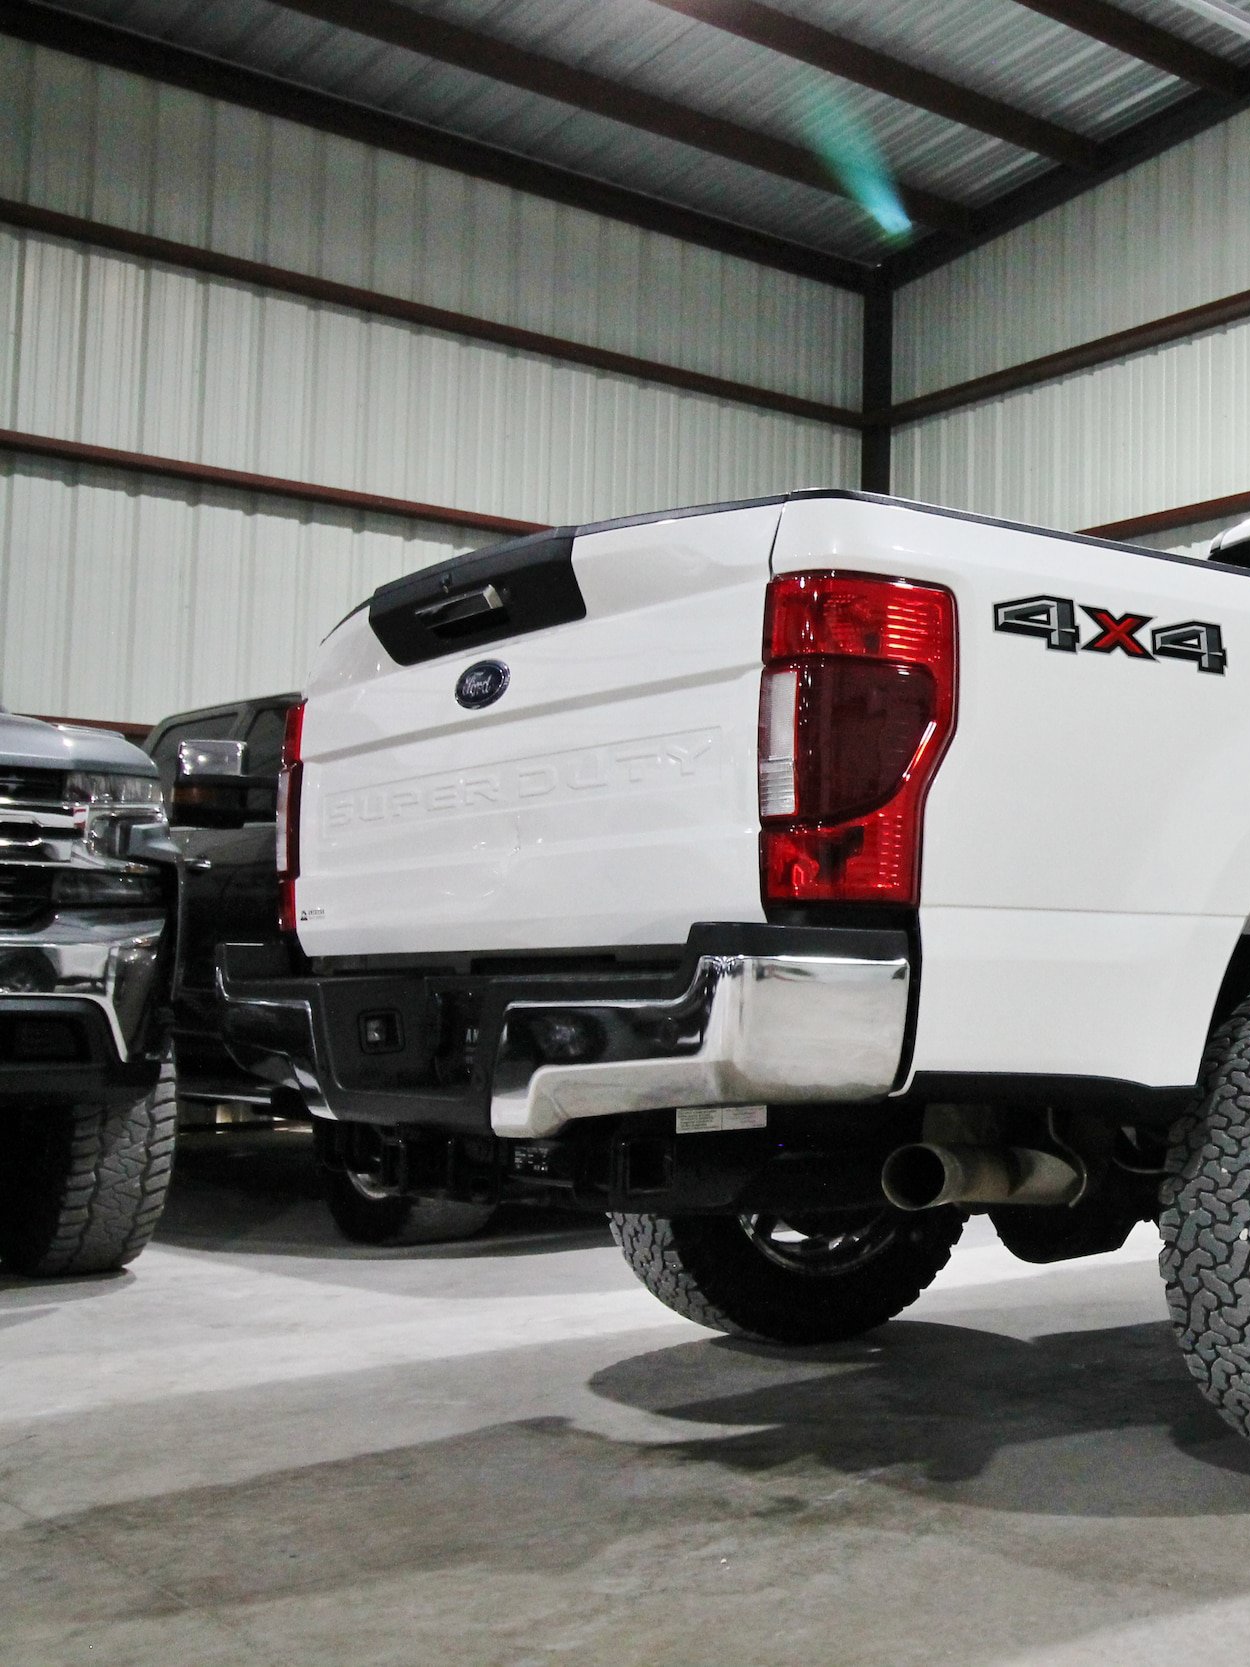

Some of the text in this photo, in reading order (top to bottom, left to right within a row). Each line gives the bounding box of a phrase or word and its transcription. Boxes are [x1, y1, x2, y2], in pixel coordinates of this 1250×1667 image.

[461, 671, 493, 697] Ford
[326, 743, 713, 829] SUPER DUTY
